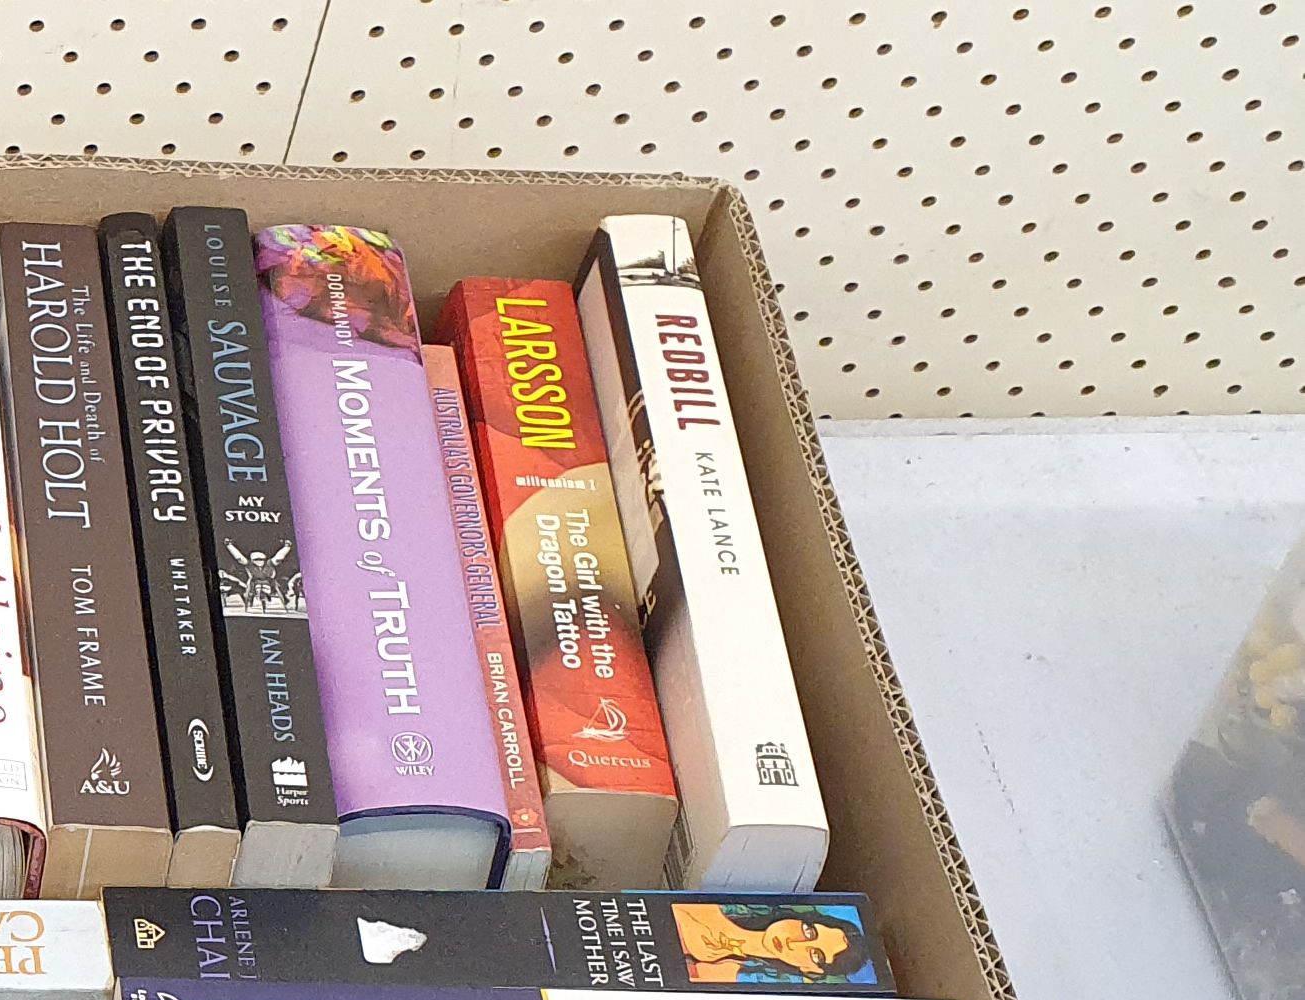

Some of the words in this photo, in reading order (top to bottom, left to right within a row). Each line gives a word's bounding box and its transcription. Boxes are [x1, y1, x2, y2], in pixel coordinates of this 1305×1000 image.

[71, 285, 91, 316] The
[327, 273, 353, 348] DORMANDY
[79, 361, 97, 385] and
[496, 297, 577, 449] LARSSON
[655, 314, 721, 431] REDBILL
[83, 392, 106, 442] Death
[225, 510, 281, 523] STORY
[239, 496, 264, 507] MY
[564, 509, 590, 547] The
[70, 565, 96, 615] TOM
[573, 554, 602, 591] Girl
[169, 558, 197, 656] WHITAKER
[581, 594, 609, 630] with
[77, 626, 107, 707] FRAME
[259, 629, 284, 665] IAN
[591, 634, 617, 680] the
[265, 672, 296, 743] HEADS
[395, 765, 435, 776] WILEY
[568, 750, 651, 770] Quercus
[80, 779, 130, 794] A&U
[276, 787, 309, 797] Harper
[276, 796, 309, 807] Sports
[229, 896, 256, 969] ARLENE
[626, 899, 650, 941] THE
[573, 898, 609, 986] MOTHER
[599, 899, 622, 936] TIME
[614, 950, 636, 988] SAW
[636, 944, 664, 987] LAST
